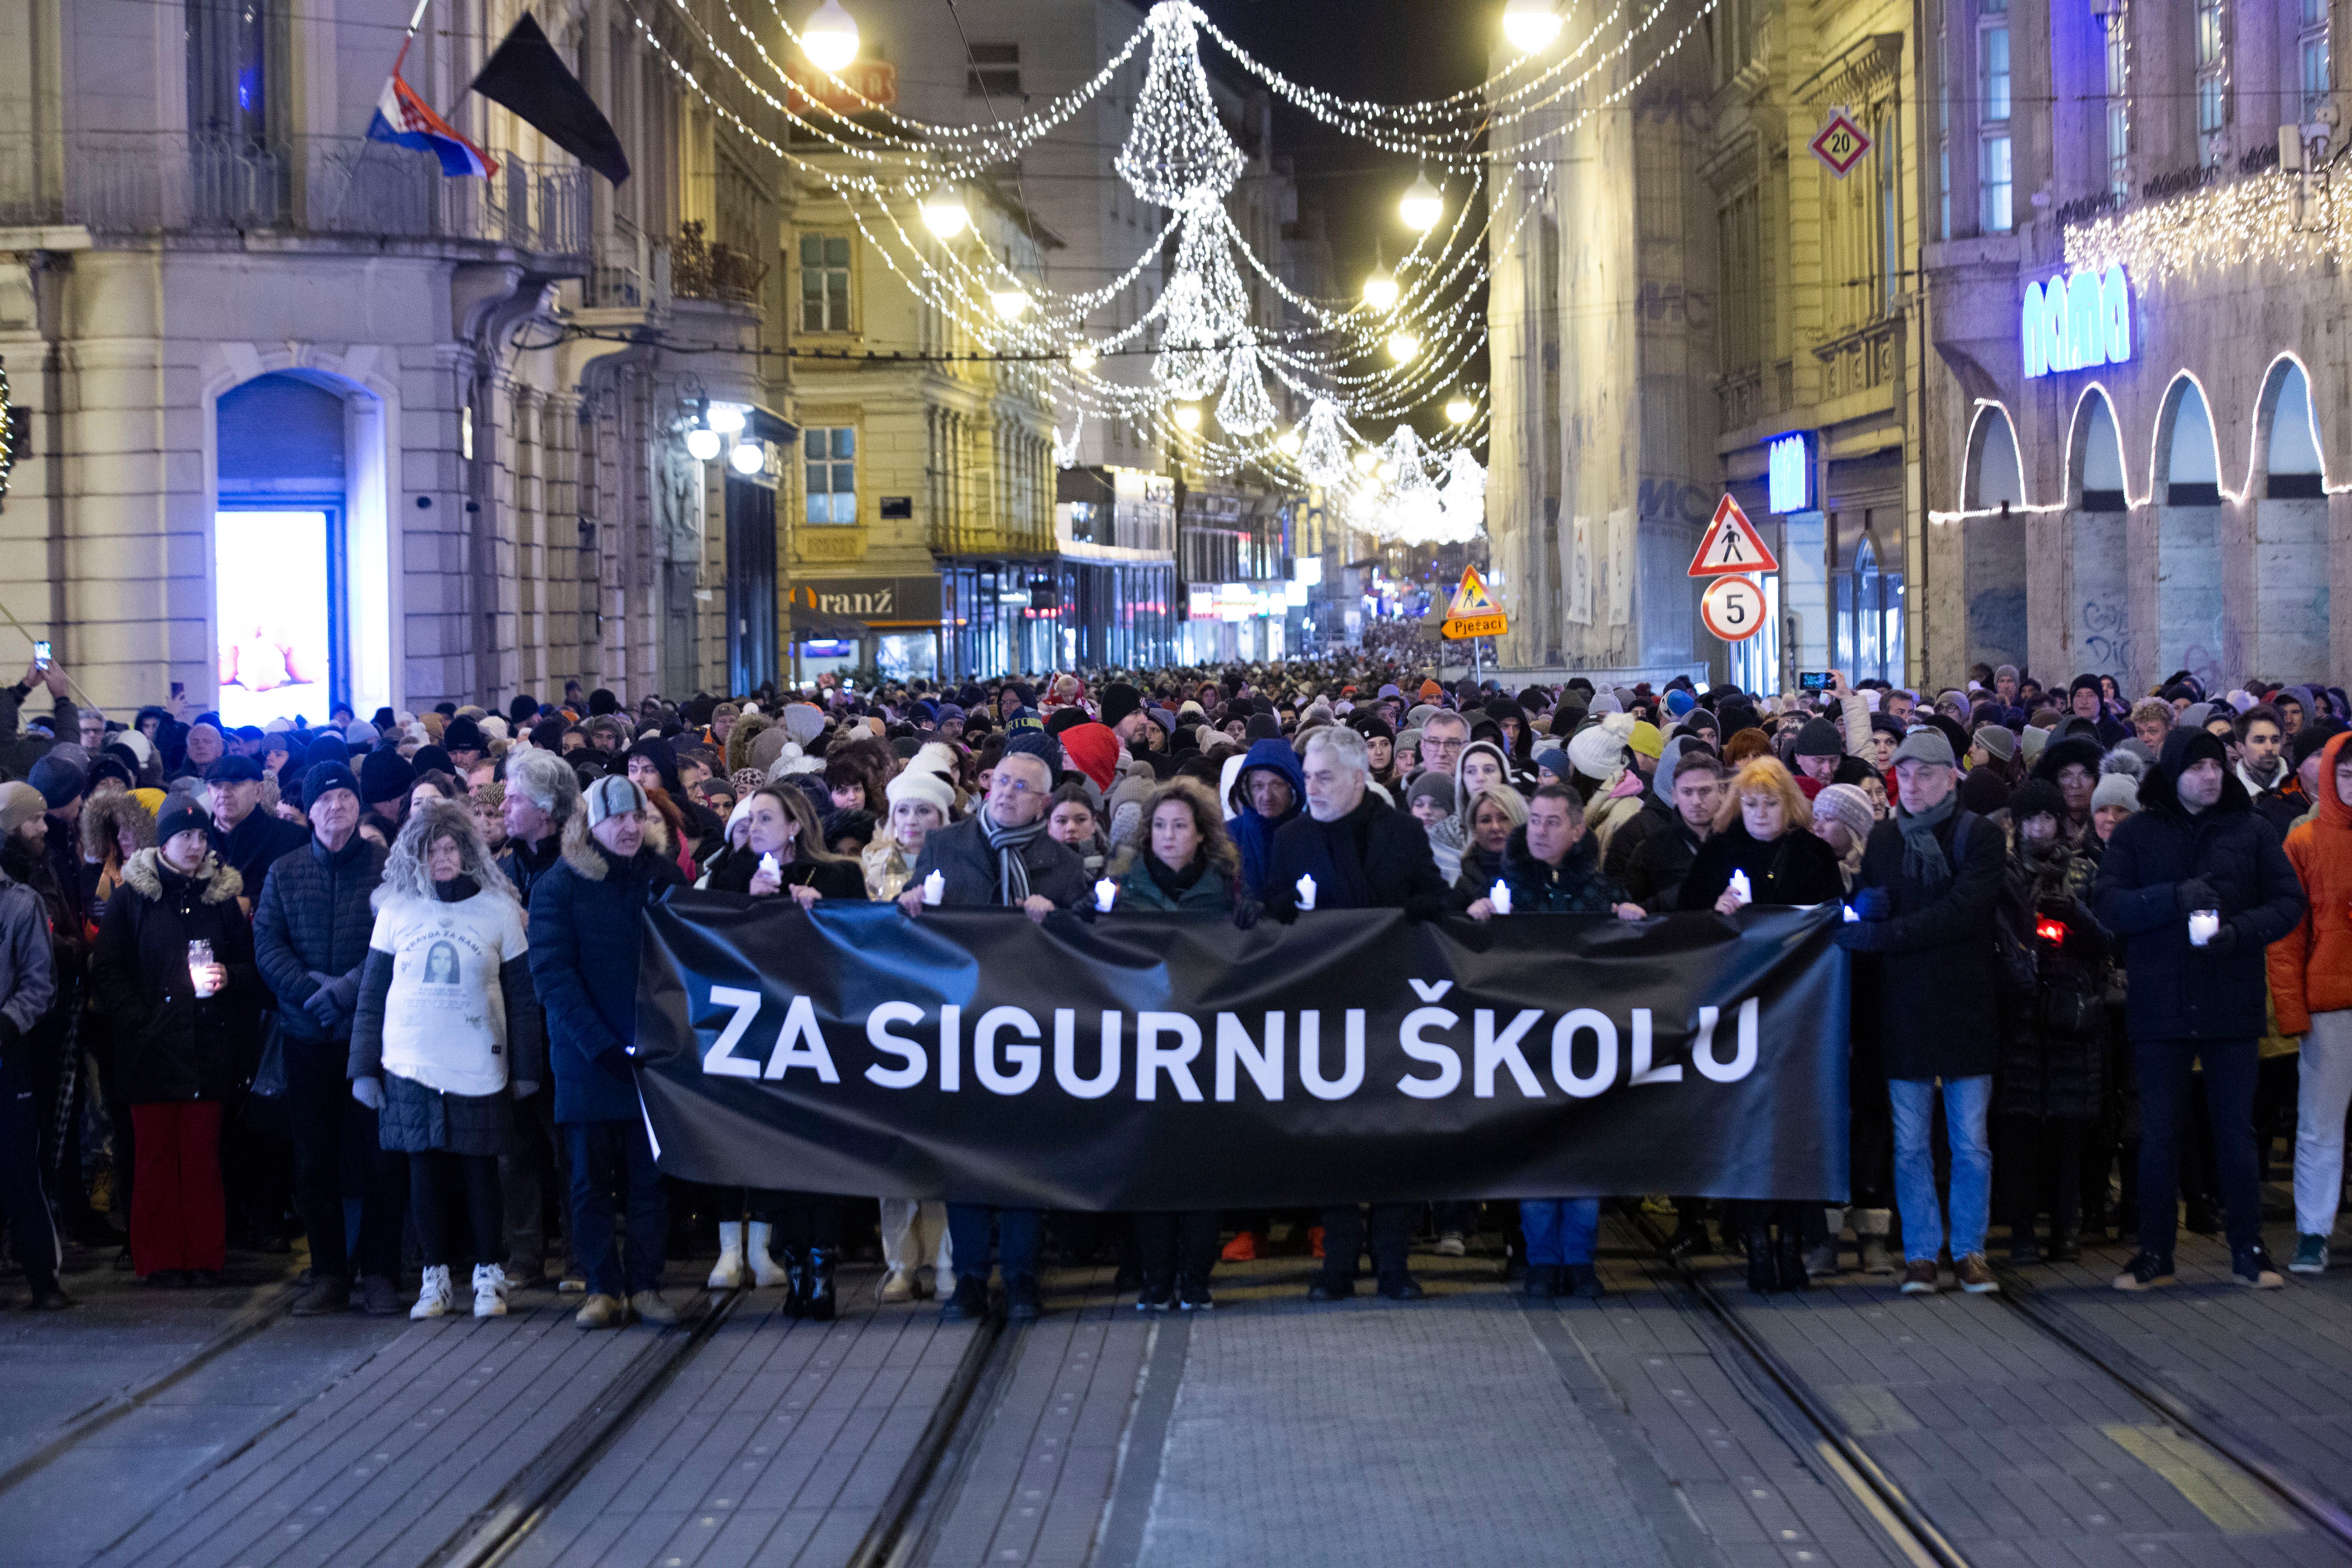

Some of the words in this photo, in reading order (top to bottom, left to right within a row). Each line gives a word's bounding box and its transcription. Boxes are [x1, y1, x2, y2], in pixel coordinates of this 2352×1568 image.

[1832, 133, 1850, 154] 20
[1726, 594, 1745, 624] 5
[702, 984, 840, 1083] ZA
[863, 1000, 1366, 1102] SIGURNU
[1396, 978, 1759, 1099] ŠKOLU
